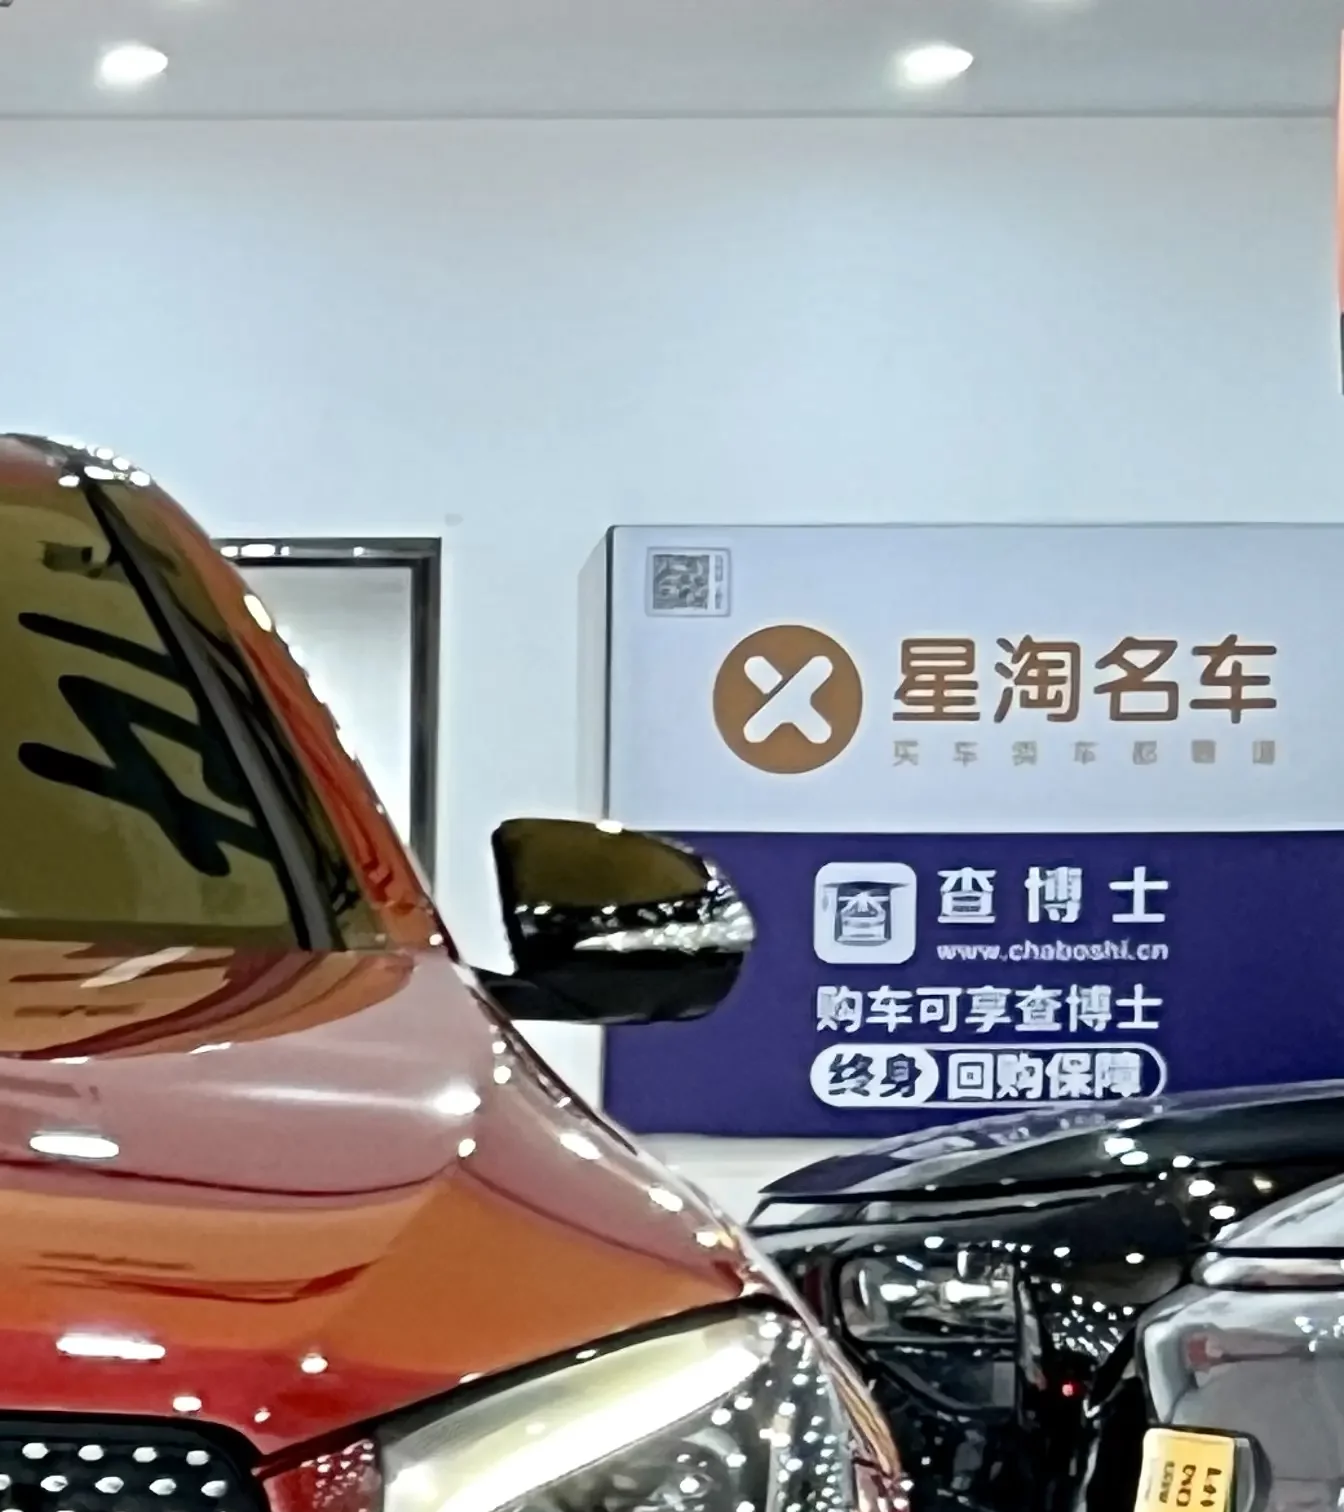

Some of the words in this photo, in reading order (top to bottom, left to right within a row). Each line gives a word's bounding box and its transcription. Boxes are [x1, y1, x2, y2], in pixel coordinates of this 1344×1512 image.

[892, 633, 1278, 724] 星淘名车
[936, 866, 1170, 925] 查博士
[936, 938, 1170, 962] www.chaboshi.cn
[815, 983, 1165, 1034] 购车可享查博士
[827, 1052, 923, 1099] 终身
[947, 1051, 1142, 1100] 回购保障
